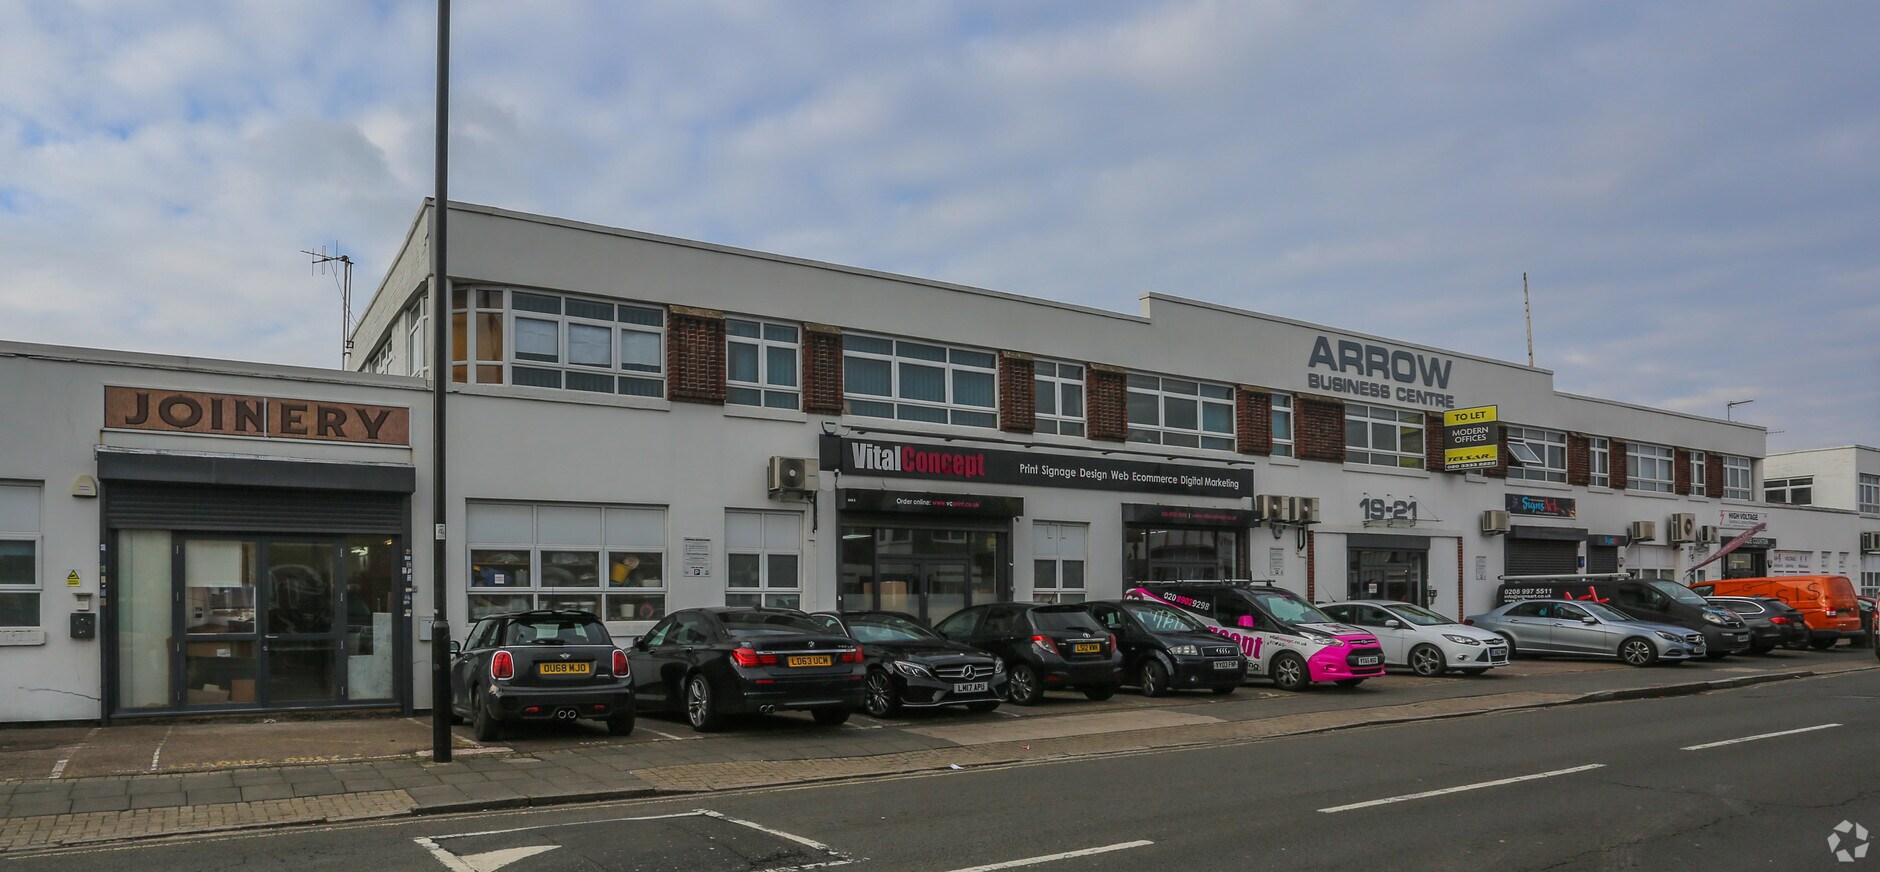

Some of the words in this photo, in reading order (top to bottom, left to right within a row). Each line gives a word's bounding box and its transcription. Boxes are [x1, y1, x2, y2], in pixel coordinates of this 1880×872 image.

[1307, 335, 1453, 390] ARROW
[1307, 372, 1391, 400] BUSINESS
[1396, 386, 1455, 409] CENTRE
[124, 391, 393, 440] JOINERY
[1454, 412, 1468, 422] TO
[1470, 410, 1487, 420] LET
[1451, 426, 1489, 438] MODERN
[1454, 433, 1487, 444] OFFICES
[851, 442, 985, 478] VitalConcept
[1019, 463, 1038, 475] Print
[1041, 465, 1076, 478] Signage
[1079, 468, 1108, 480] Design
[1111, 470, 1129, 481] Web
[1132, 472, 1178, 485] Ecommerce
[1180, 475, 1204, 487] Digital
[1204, 477, 1239, 490] Marketing
[896, 497, 912, 505] Order
[1359, 497, 1417, 520] 19-21
[1728, 512, 1740, 520] HIGH
[1740, 513, 1759, 521] VOLTAGE
[791, 657, 812, 666] LD63
[813, 656, 829, 665] UCW
[957, 684, 973, 692] LM17
[973, 683, 985, 691] APU
